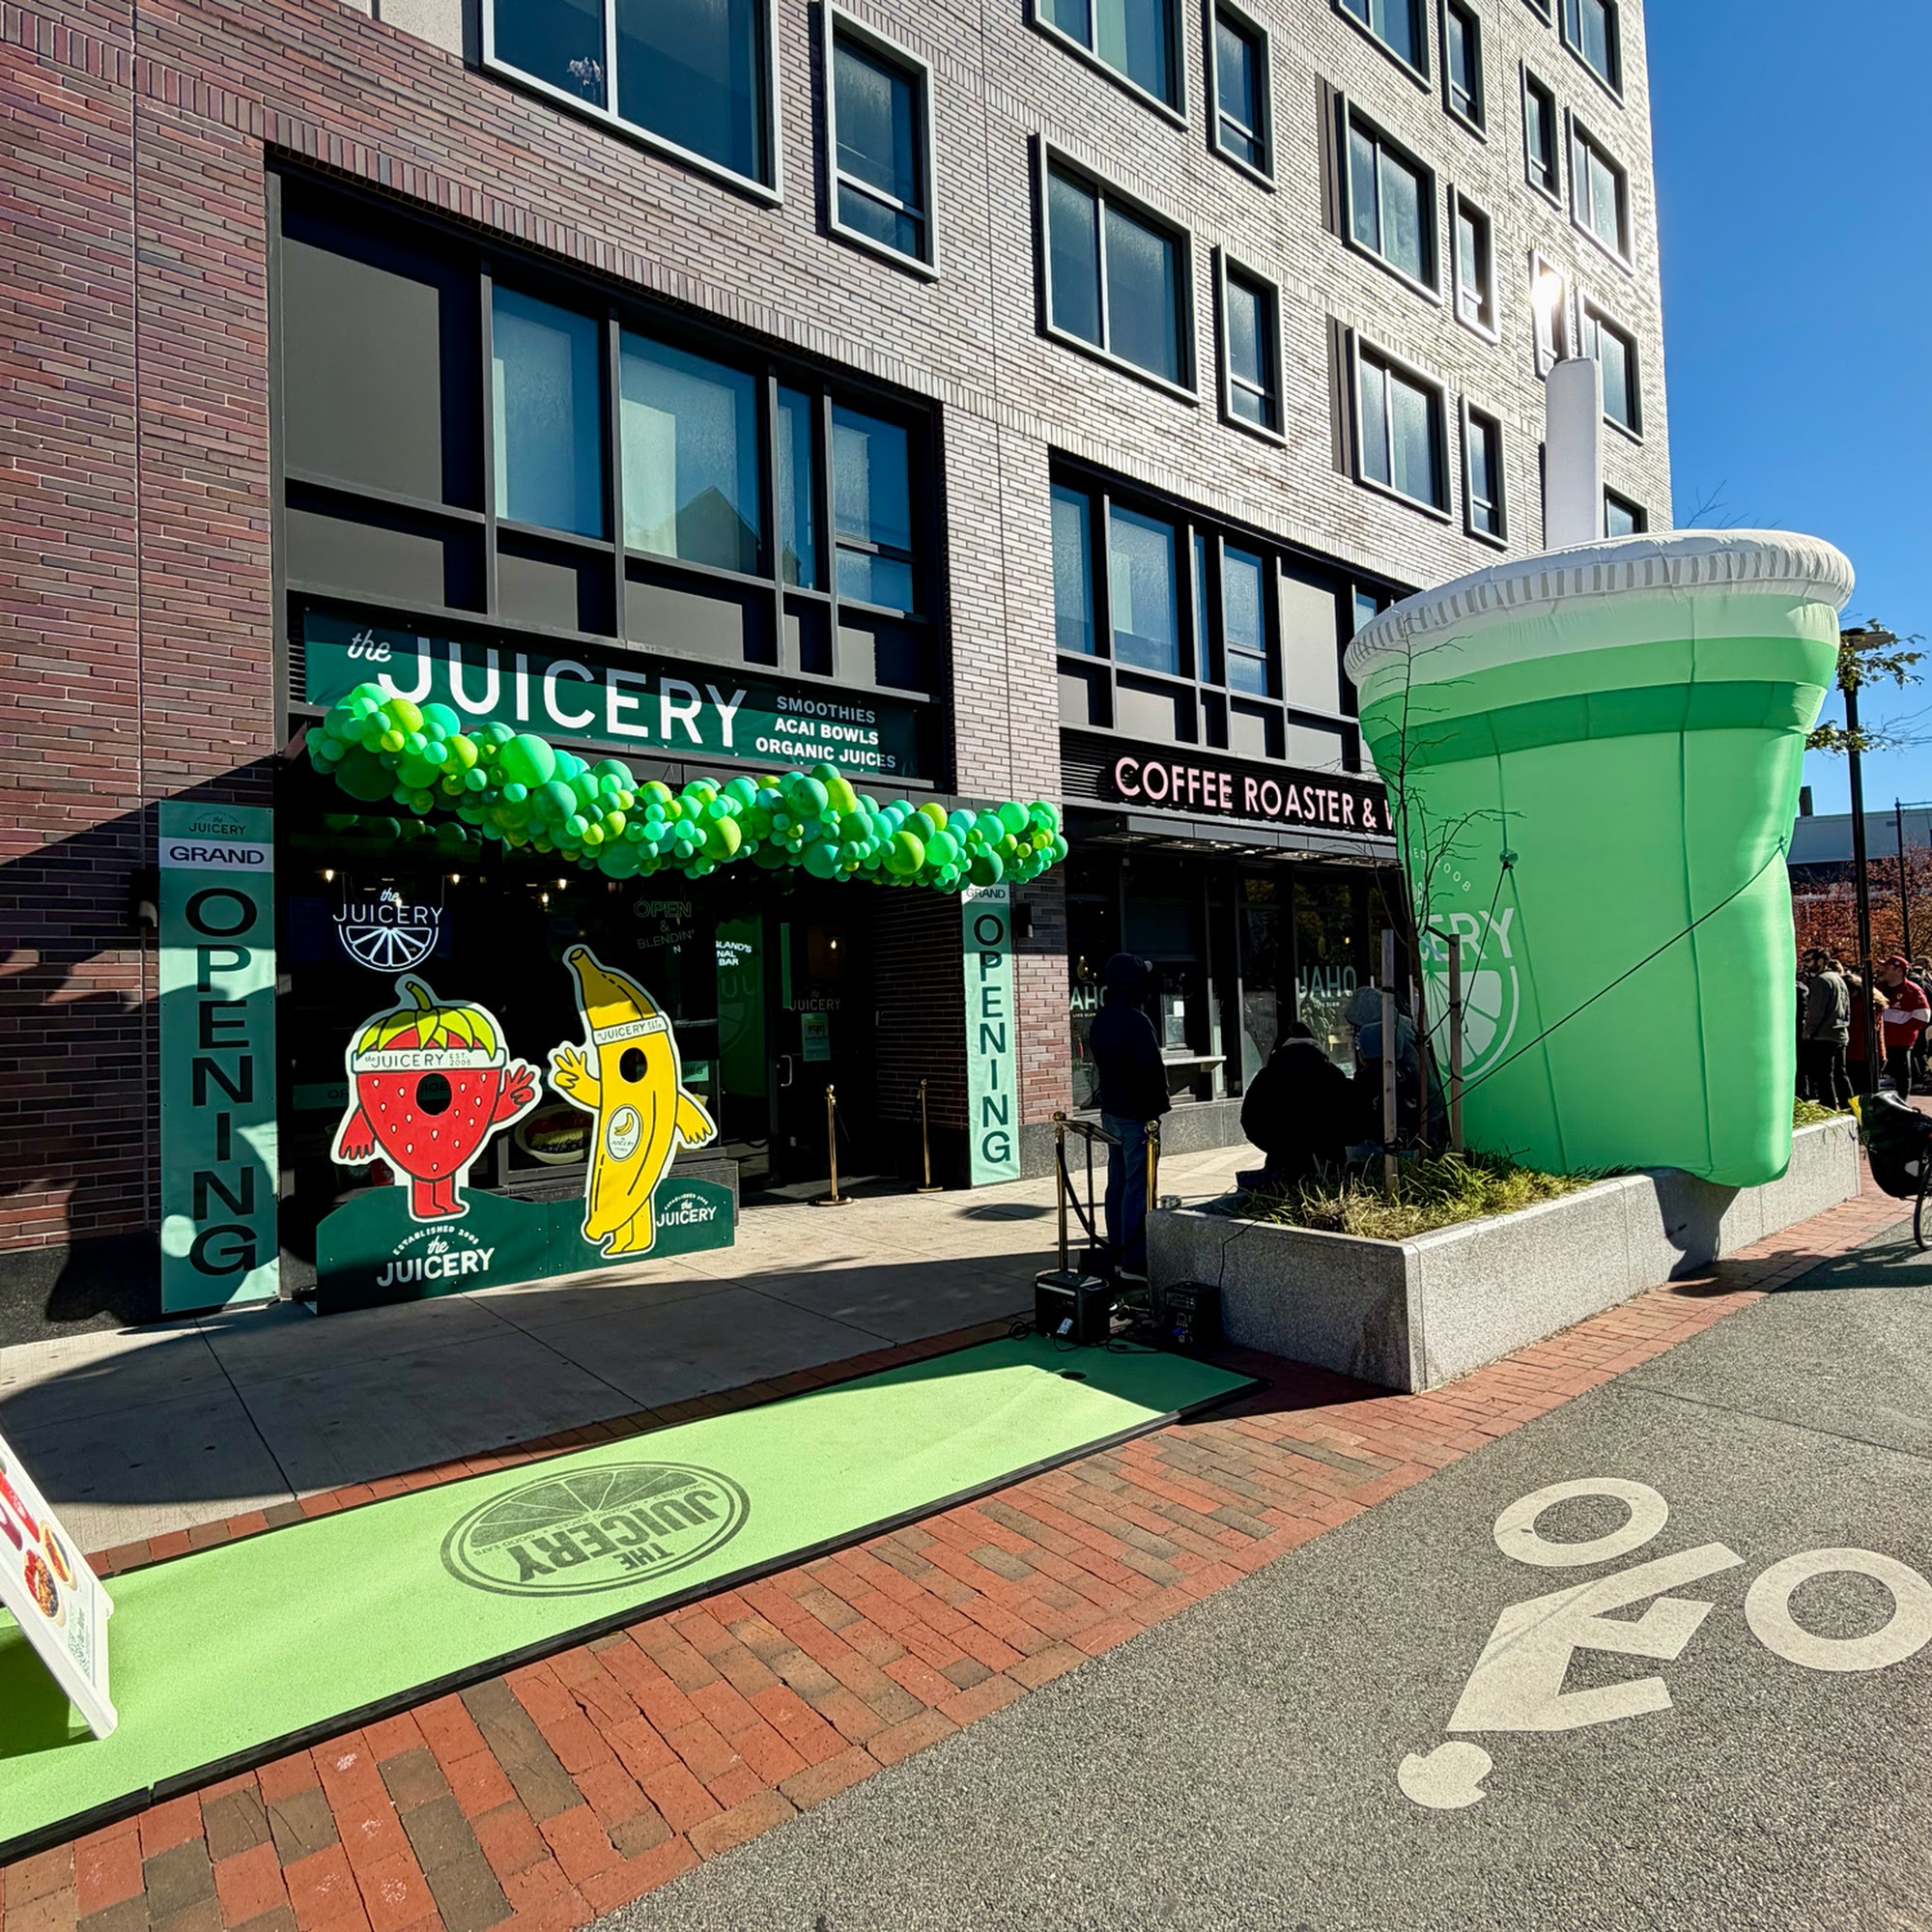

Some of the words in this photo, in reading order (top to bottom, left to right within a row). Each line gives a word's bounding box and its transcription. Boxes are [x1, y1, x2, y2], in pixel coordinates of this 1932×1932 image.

[346, 630, 392, 663] the
[378, 636, 748, 748] JUICERY
[777, 696, 876, 724] SMOOTHIES
[775, 718, 815, 737] ACAI
[820, 724, 879, 745] BOWLS
[755, 737, 835, 760] ORGANIC
[838, 749, 896, 769] JUICES
[1115, 756, 1233, 810] COFFEE
[1243, 777, 1355, 826] ROASTER
[1362, 797, 1378, 829] &
[188, 822, 246, 836] JUICERY
[169, 845, 265, 865] GRAND
[380, 887, 400, 902] the
[966, 888, 1006, 899] GRAND
[332, 903, 443, 924] JUICERY
[634, 899, 692, 918] OPEN
[660, 920, 669, 932] &
[637, 929, 695, 950] BLENDIN'
[1299, 965, 1357, 999] JAHO
[789, 998, 841, 1011] JUICERY
[601, 1023, 645, 1040] JUICERY
[973, 914, 1011, 1164] OPENING
[371, 1053, 444, 1068] JUICERY
[185, 887, 259, 1276] OPENING
[656, 1206, 717, 1227] JUICERY
[392, 1225, 455, 1256] ESTABLISHED
[427, 1236, 449, 1255] the
[377, 1247, 496, 1287] JUICERY
[654, 1482, 707, 1501] SMOOTHIES
[592, 1502, 638, 1520] ORGANIC
[554, 1516, 588, 1529] JUICES
[502, 1534, 535, 1547] GOOD
[506, 1490, 721, 1582] JUICERY
[473, 1544, 500, 1556] EATS
[612, 1542, 675, 1571] THE
